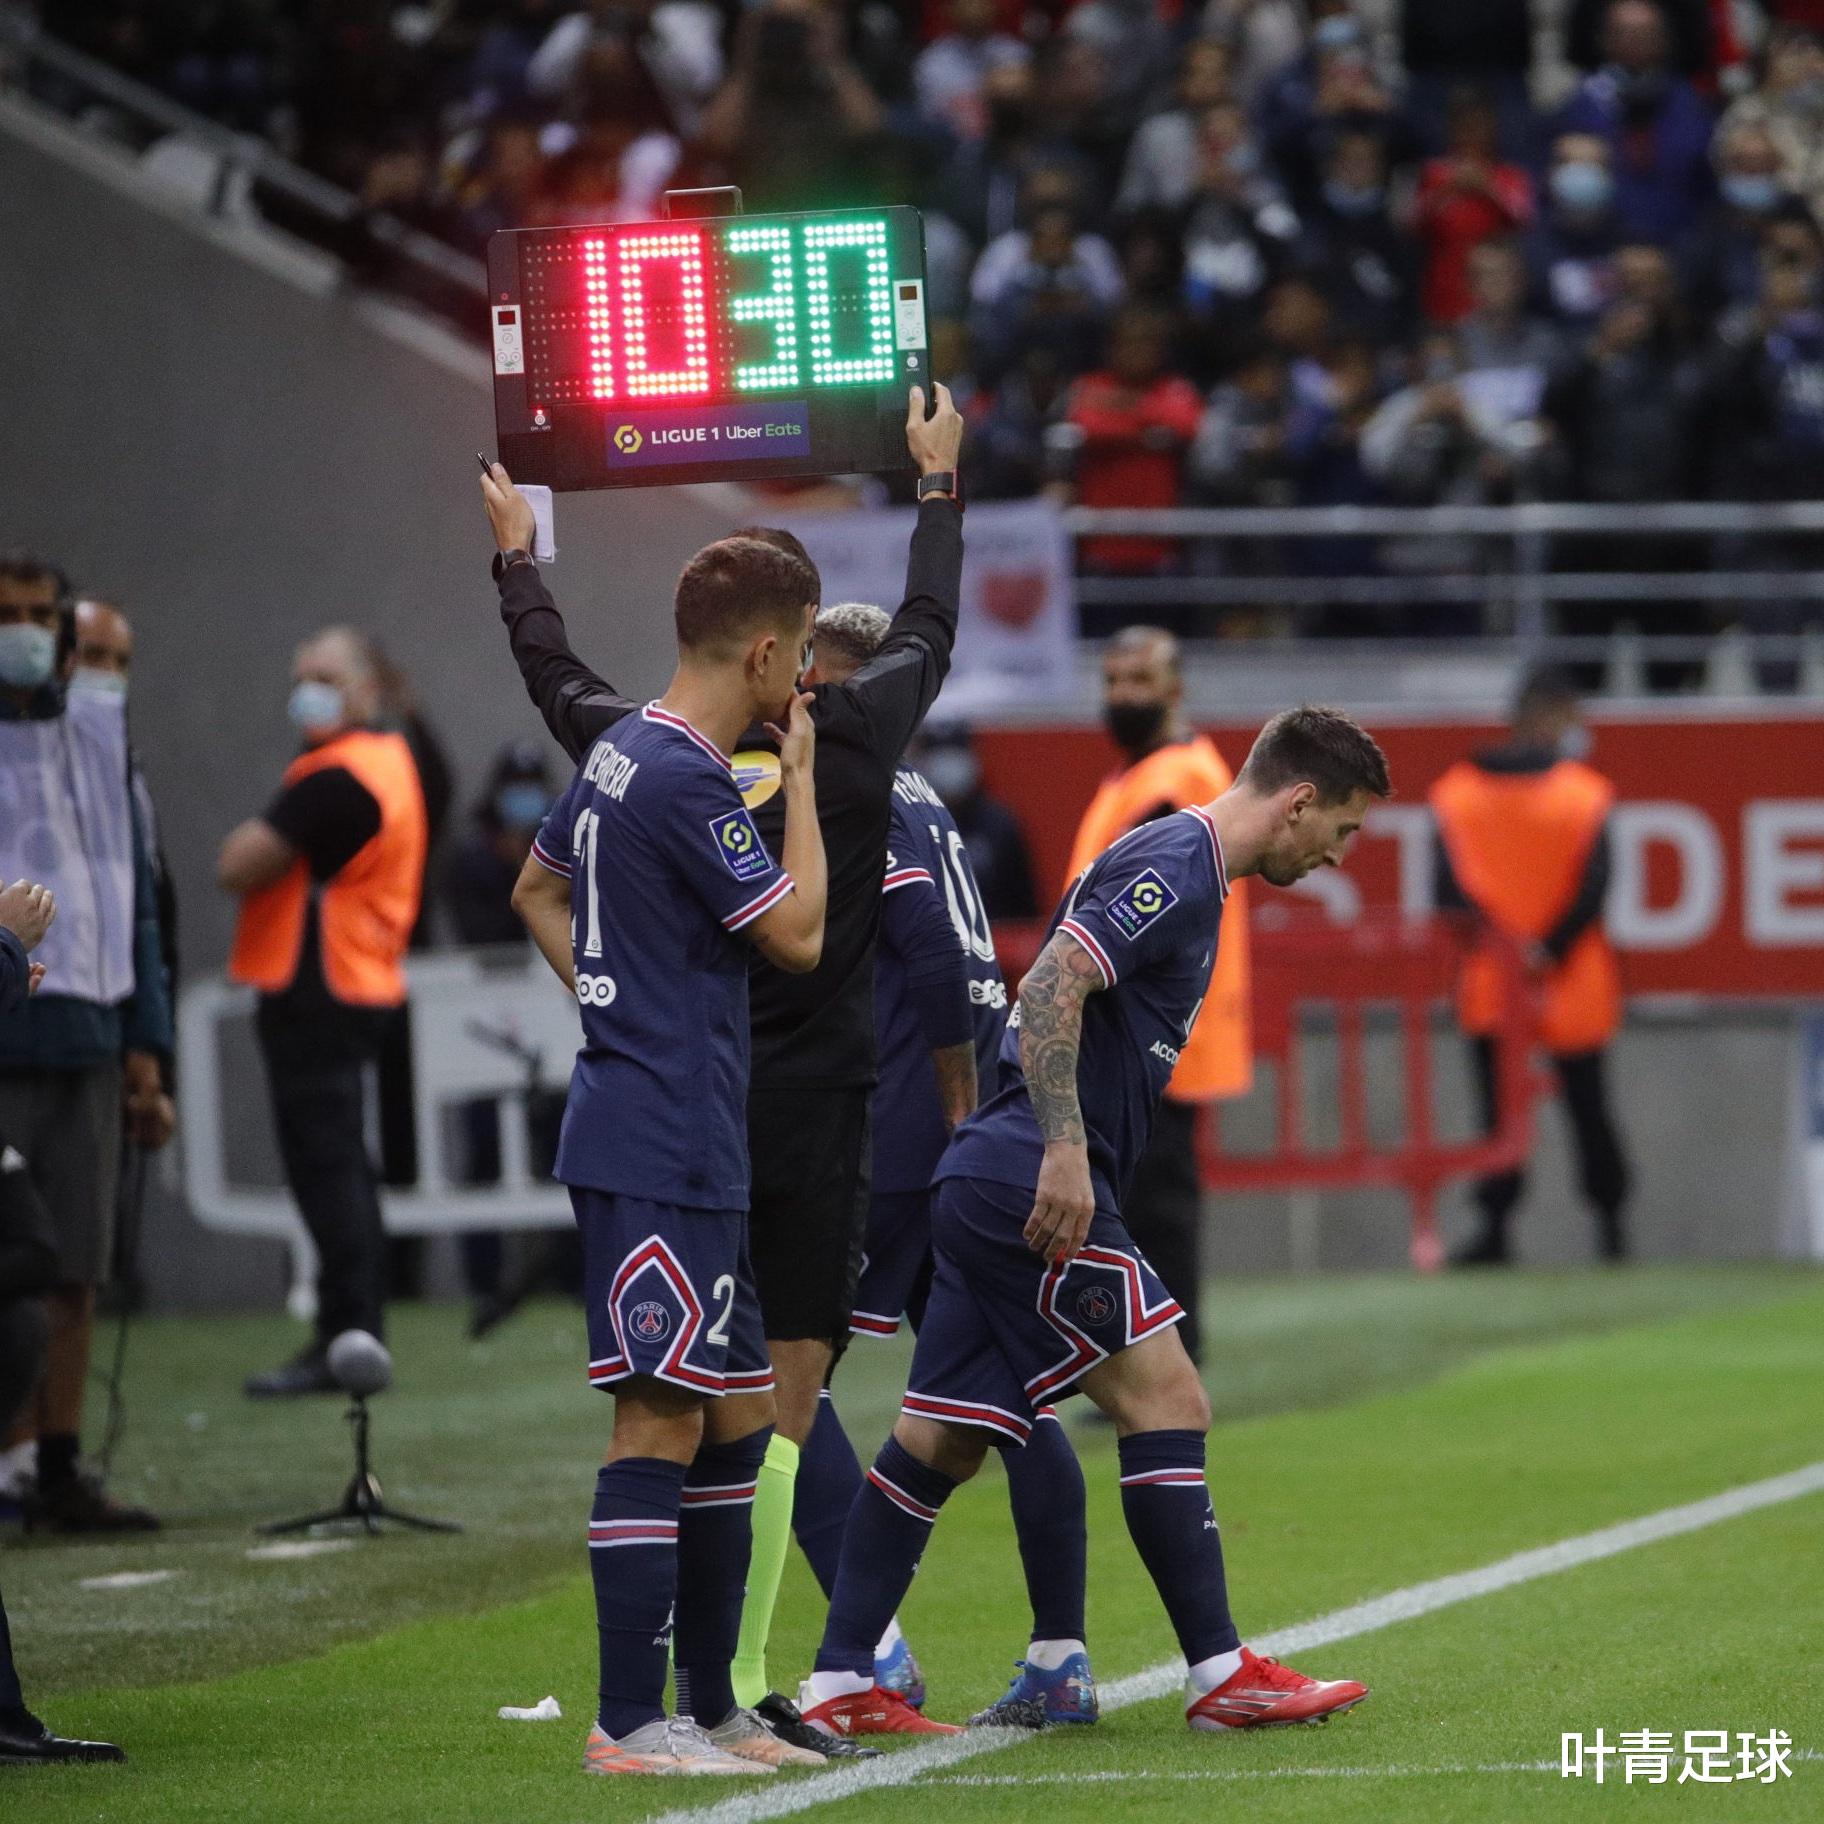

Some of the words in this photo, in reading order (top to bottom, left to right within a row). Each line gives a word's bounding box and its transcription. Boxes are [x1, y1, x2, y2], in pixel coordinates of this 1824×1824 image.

[583, 234, 709, 398] 10
[729, 222, 895, 389] 30
[651, 428, 707, 445] LIGUE
[711, 427, 720, 440] 1
[726, 425, 763, 439] Uber
[765, 423, 802, 437] Eats
[733, 852, 757, 867] LIGUE
[1118, 900, 1139, 922] LIGUE
[636, 1303, 665, 1316] PARIS
